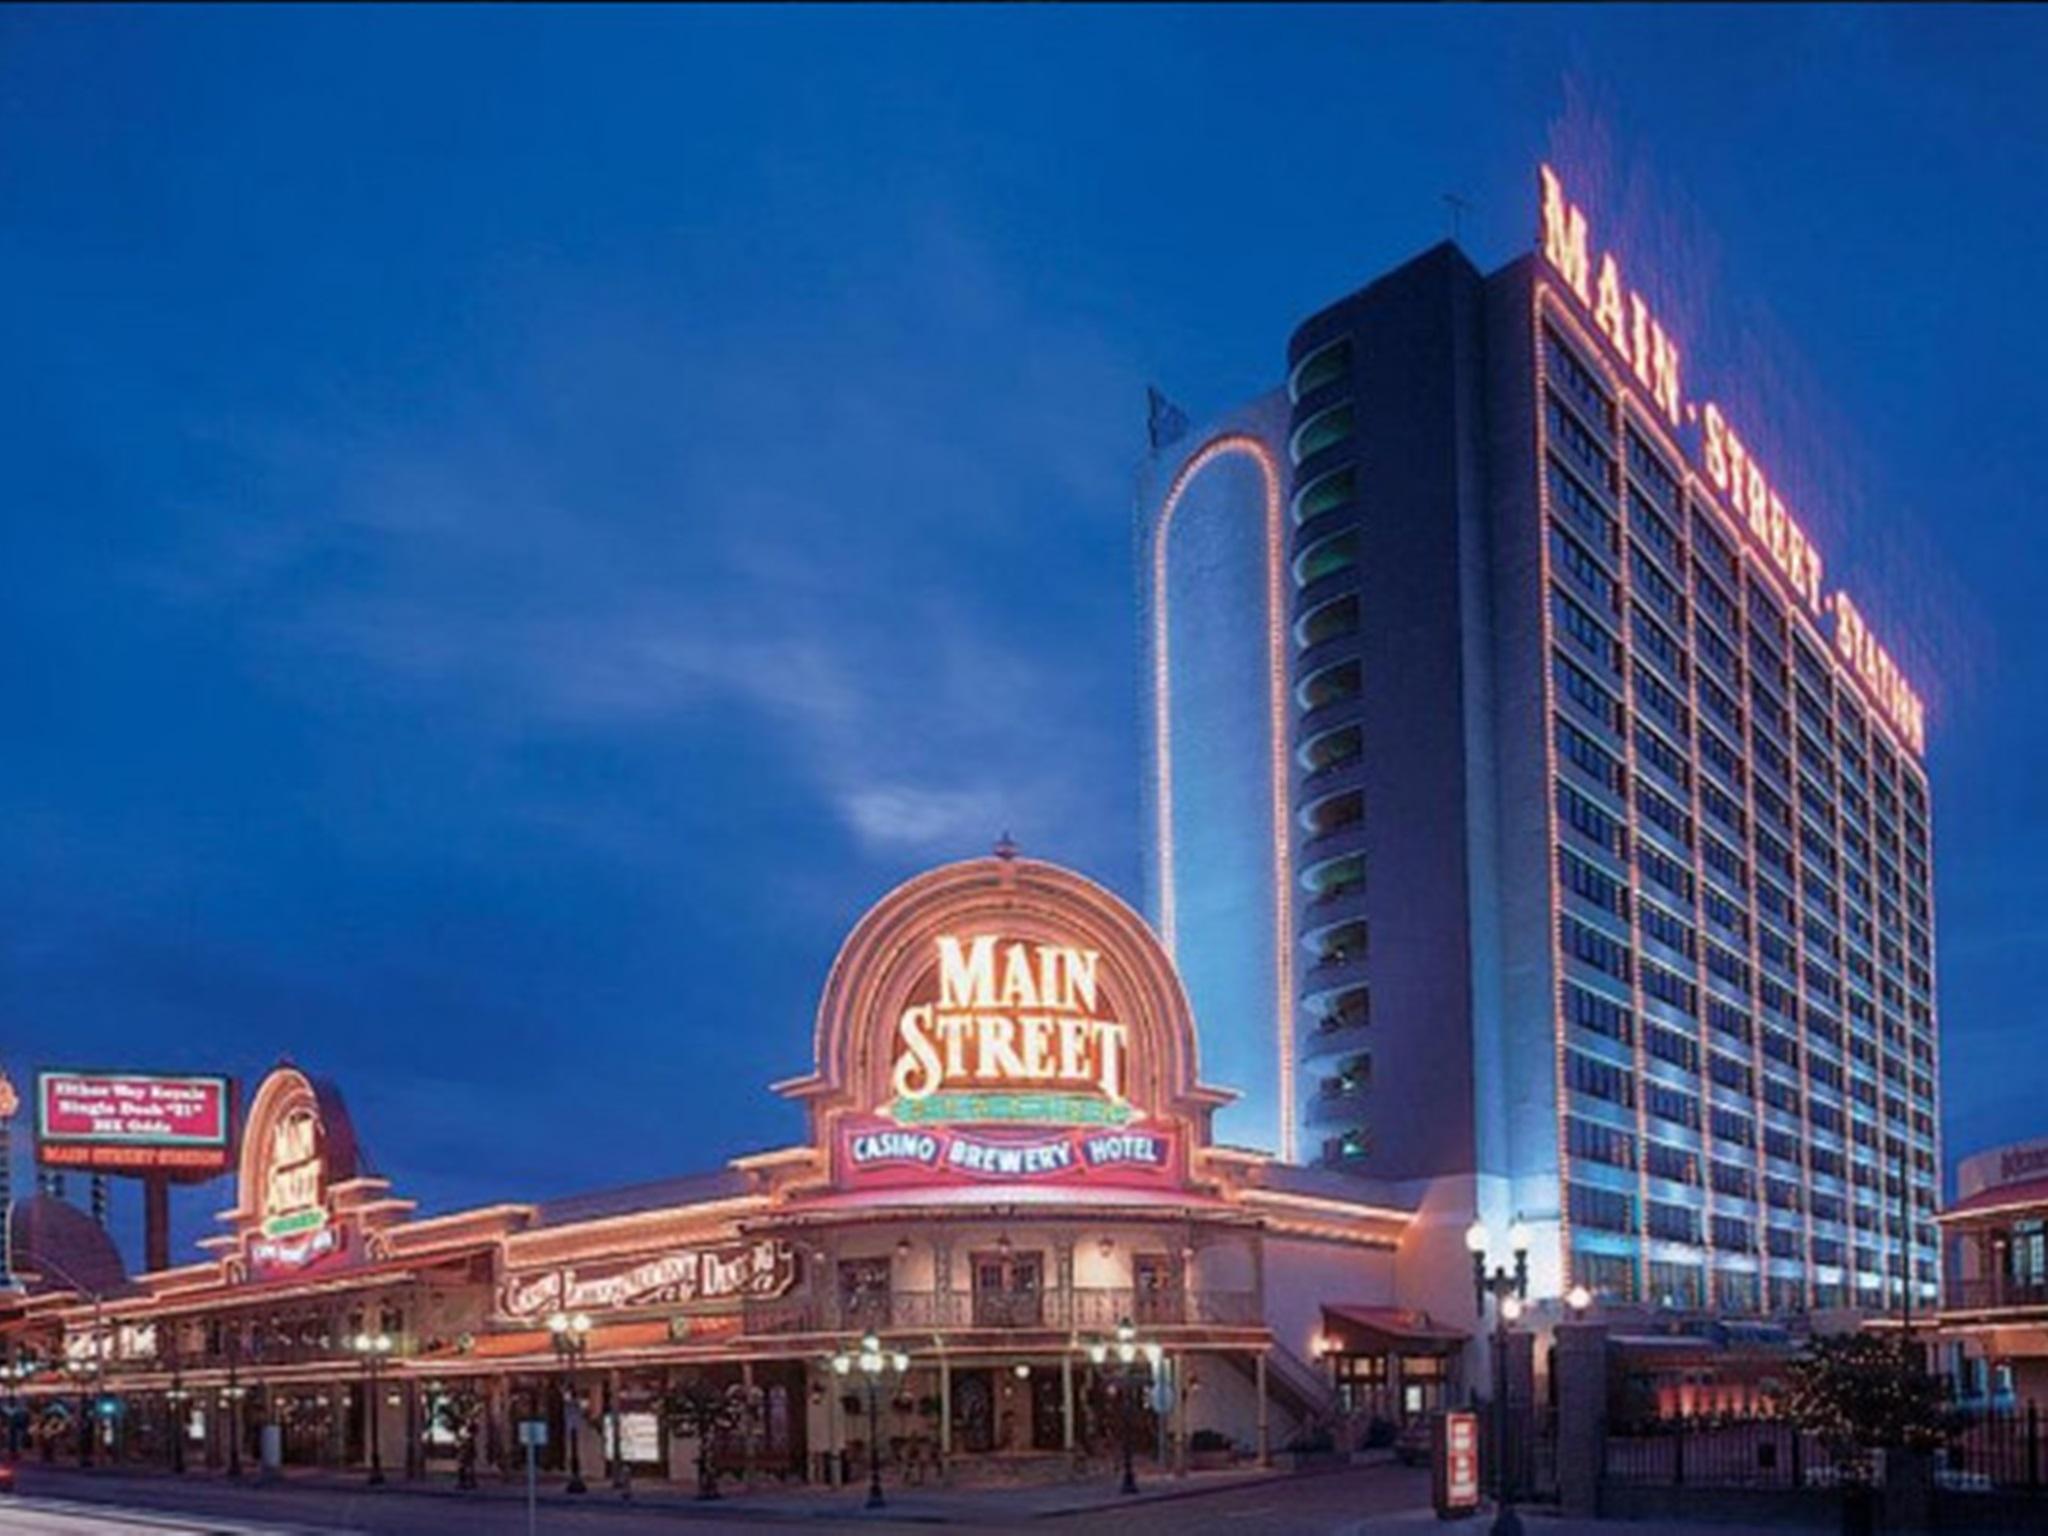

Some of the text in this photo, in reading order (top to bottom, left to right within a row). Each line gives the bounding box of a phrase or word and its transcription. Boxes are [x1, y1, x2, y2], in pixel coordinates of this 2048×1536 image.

[1541, 164, 1680, 426] MAIN
[1705, 403, 1822, 615] STREET
[936, 935, 1099, 1013] MAIN
[893, 1004, 1128, 1104] STREET
[852, 1132, 1158, 1173] CASINO BREWERY HOTEL
